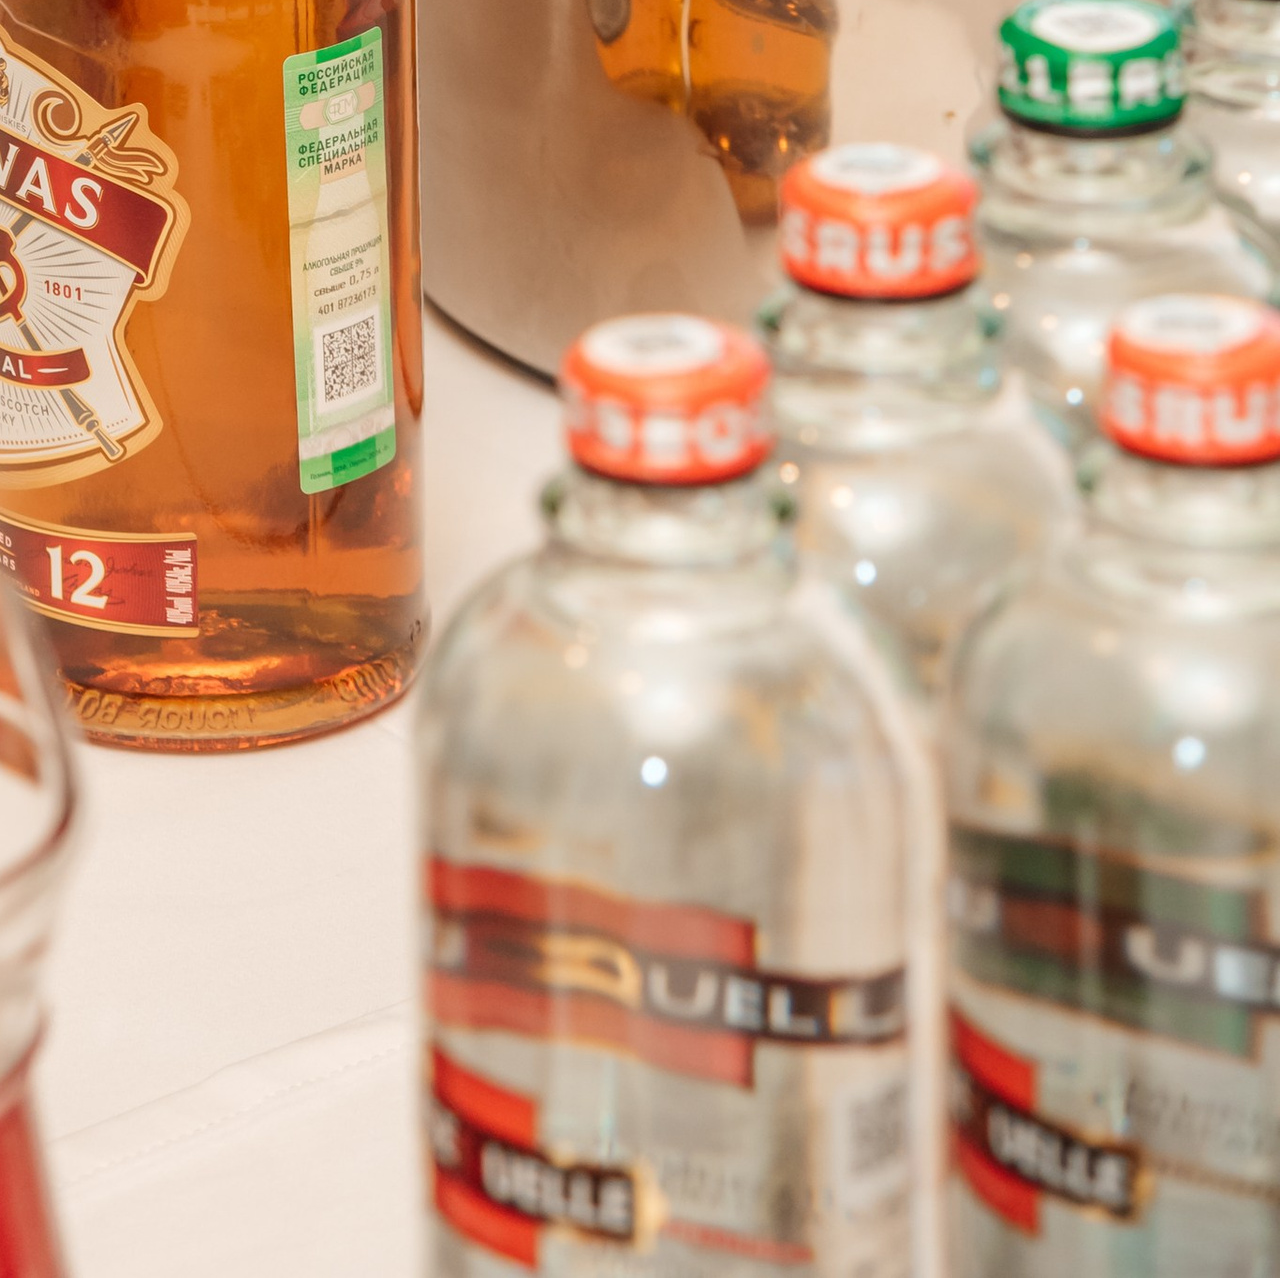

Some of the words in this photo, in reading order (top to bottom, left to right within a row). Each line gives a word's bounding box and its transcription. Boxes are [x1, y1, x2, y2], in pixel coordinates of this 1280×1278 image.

[297, 49, 375, 85] РОССИЙСКАЯ
[299, 61, 375, 97] ФЕДЕРАЦИЯ
[297, 118, 378, 156] ФЕДЕРАЛЬНАЯ
[297, 130, 379, 169] СПЕЦИАЛЬНАЯ
[323, 153, 363, 176] МАРКА
[43, 279, 83, 302] 1801
[0, 394, 51, 417] SCOTCH
[45, 544, 109, 611] 12
